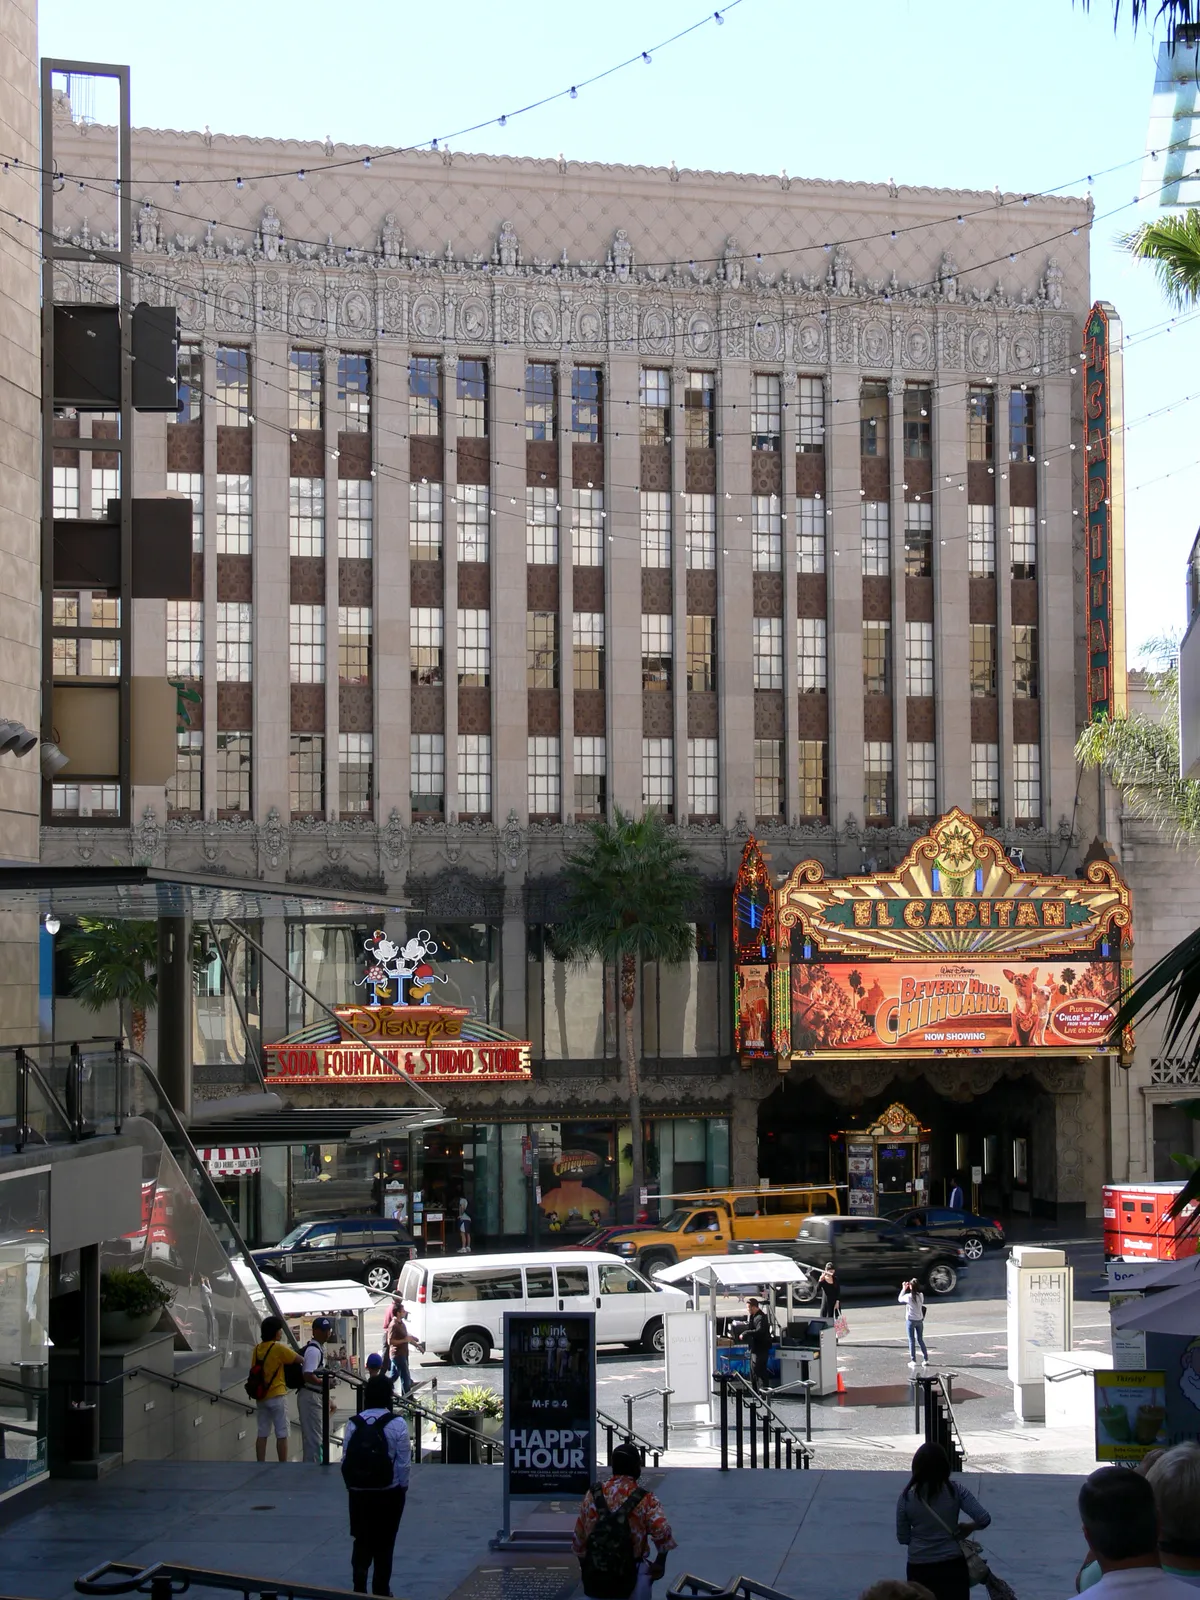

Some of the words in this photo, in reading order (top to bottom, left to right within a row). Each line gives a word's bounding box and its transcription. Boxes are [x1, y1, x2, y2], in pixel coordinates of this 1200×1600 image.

[1087, 380, 1108, 703] CAPITAN
[852, 900, 895, 927] EL
[903, 900, 1067, 928] CAPITAN
[900, 977, 968, 1005] BEVERLY
[969, 978, 1001, 997] HILLS
[875, 994, 1009, 1045] CHIHUAHUA
[924, 1033, 945, 1041] NOW
[946, 1032, 986, 1041] SHOWING
[1064, 1026, 1077, 1034] LIVE
[277, 1050, 320, 1076] SODA
[323, 1049, 399, 1076] FOUNTAIN
[405, 1051, 416, 1074] &
[420, 1048, 474, 1075] STUDIO
[478, 1047, 523, 1073] STORE
[1030, 1274, 1061, 1290] H&H
[1030, 1290, 1061, 1301] hollywood
[532, 1325, 567, 1336] uWink
[532, 1400, 550, 1408] M-F
[561, 1400, 568, 1408] 4
[510, 1429, 589, 1449] HAPPY
[514, 1448, 585, 1469] HOUR
